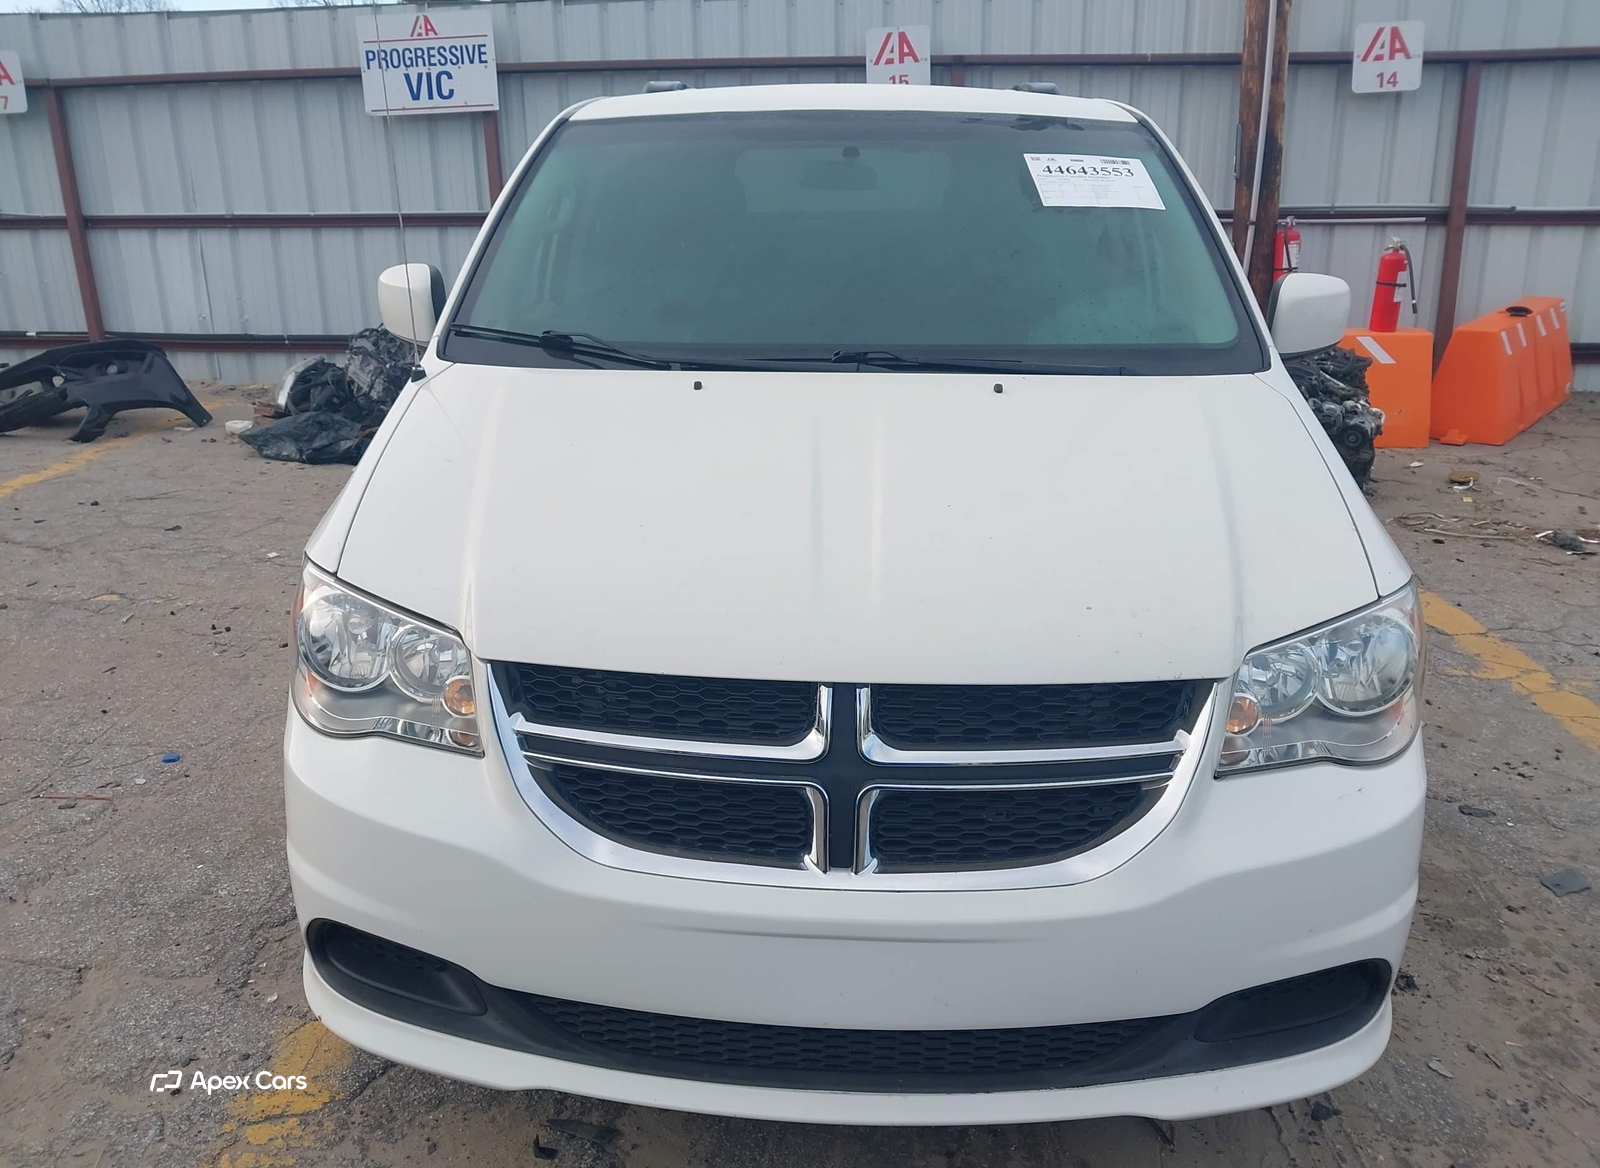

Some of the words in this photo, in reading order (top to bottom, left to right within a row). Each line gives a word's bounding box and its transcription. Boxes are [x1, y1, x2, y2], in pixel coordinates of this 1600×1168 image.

[364, 43, 489, 71] PROGRESSIVE
[403, 70, 455, 102] VIC
[1376, 71, 1399, 89] 14
[1042, 164, 1135, 178] 44643553
